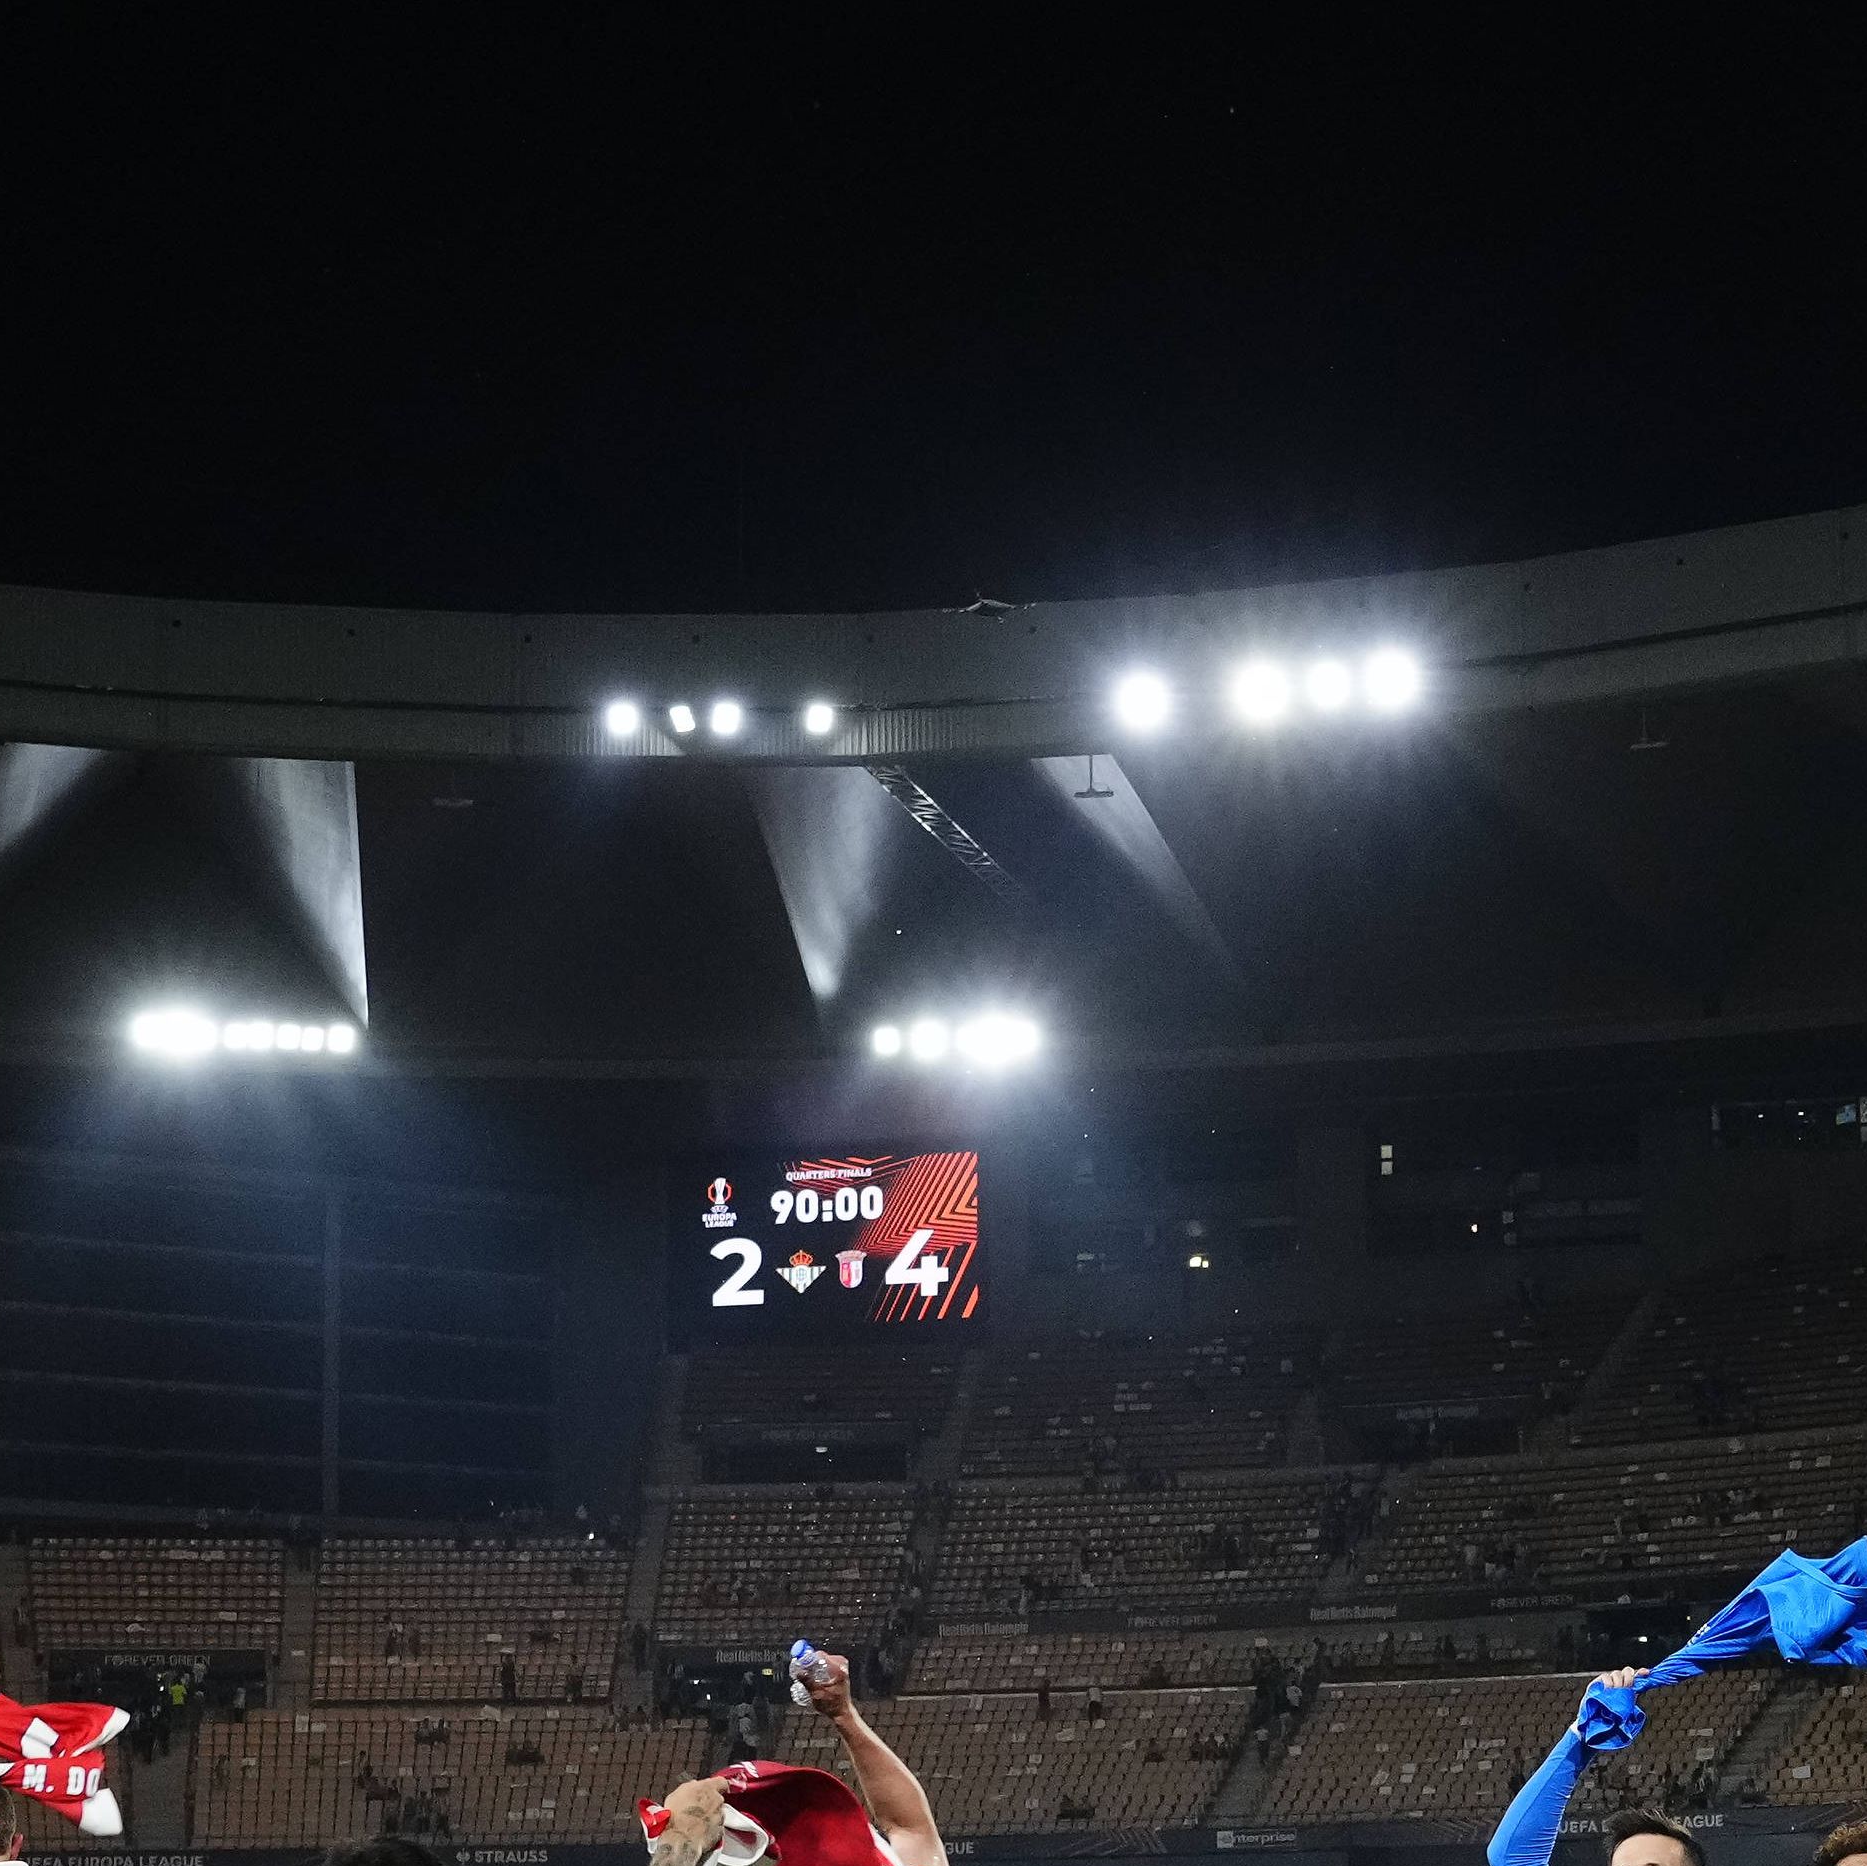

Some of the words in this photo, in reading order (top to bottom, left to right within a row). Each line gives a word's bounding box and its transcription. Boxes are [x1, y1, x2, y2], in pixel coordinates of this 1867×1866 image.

[770, 1185, 884, 1225] 90:00
[701, 1212, 737, 1223] EUROPA
[704, 1220, 734, 1228] LEAGUE
[710, 1237, 765, 1307] 2
[885, 1229, 949, 1297] 4
[22, 1764, 55, 1794] M.
[1676, 1813, 1725, 1829] EAGUE
[474, 1849, 549, 1864] STRAUSS
